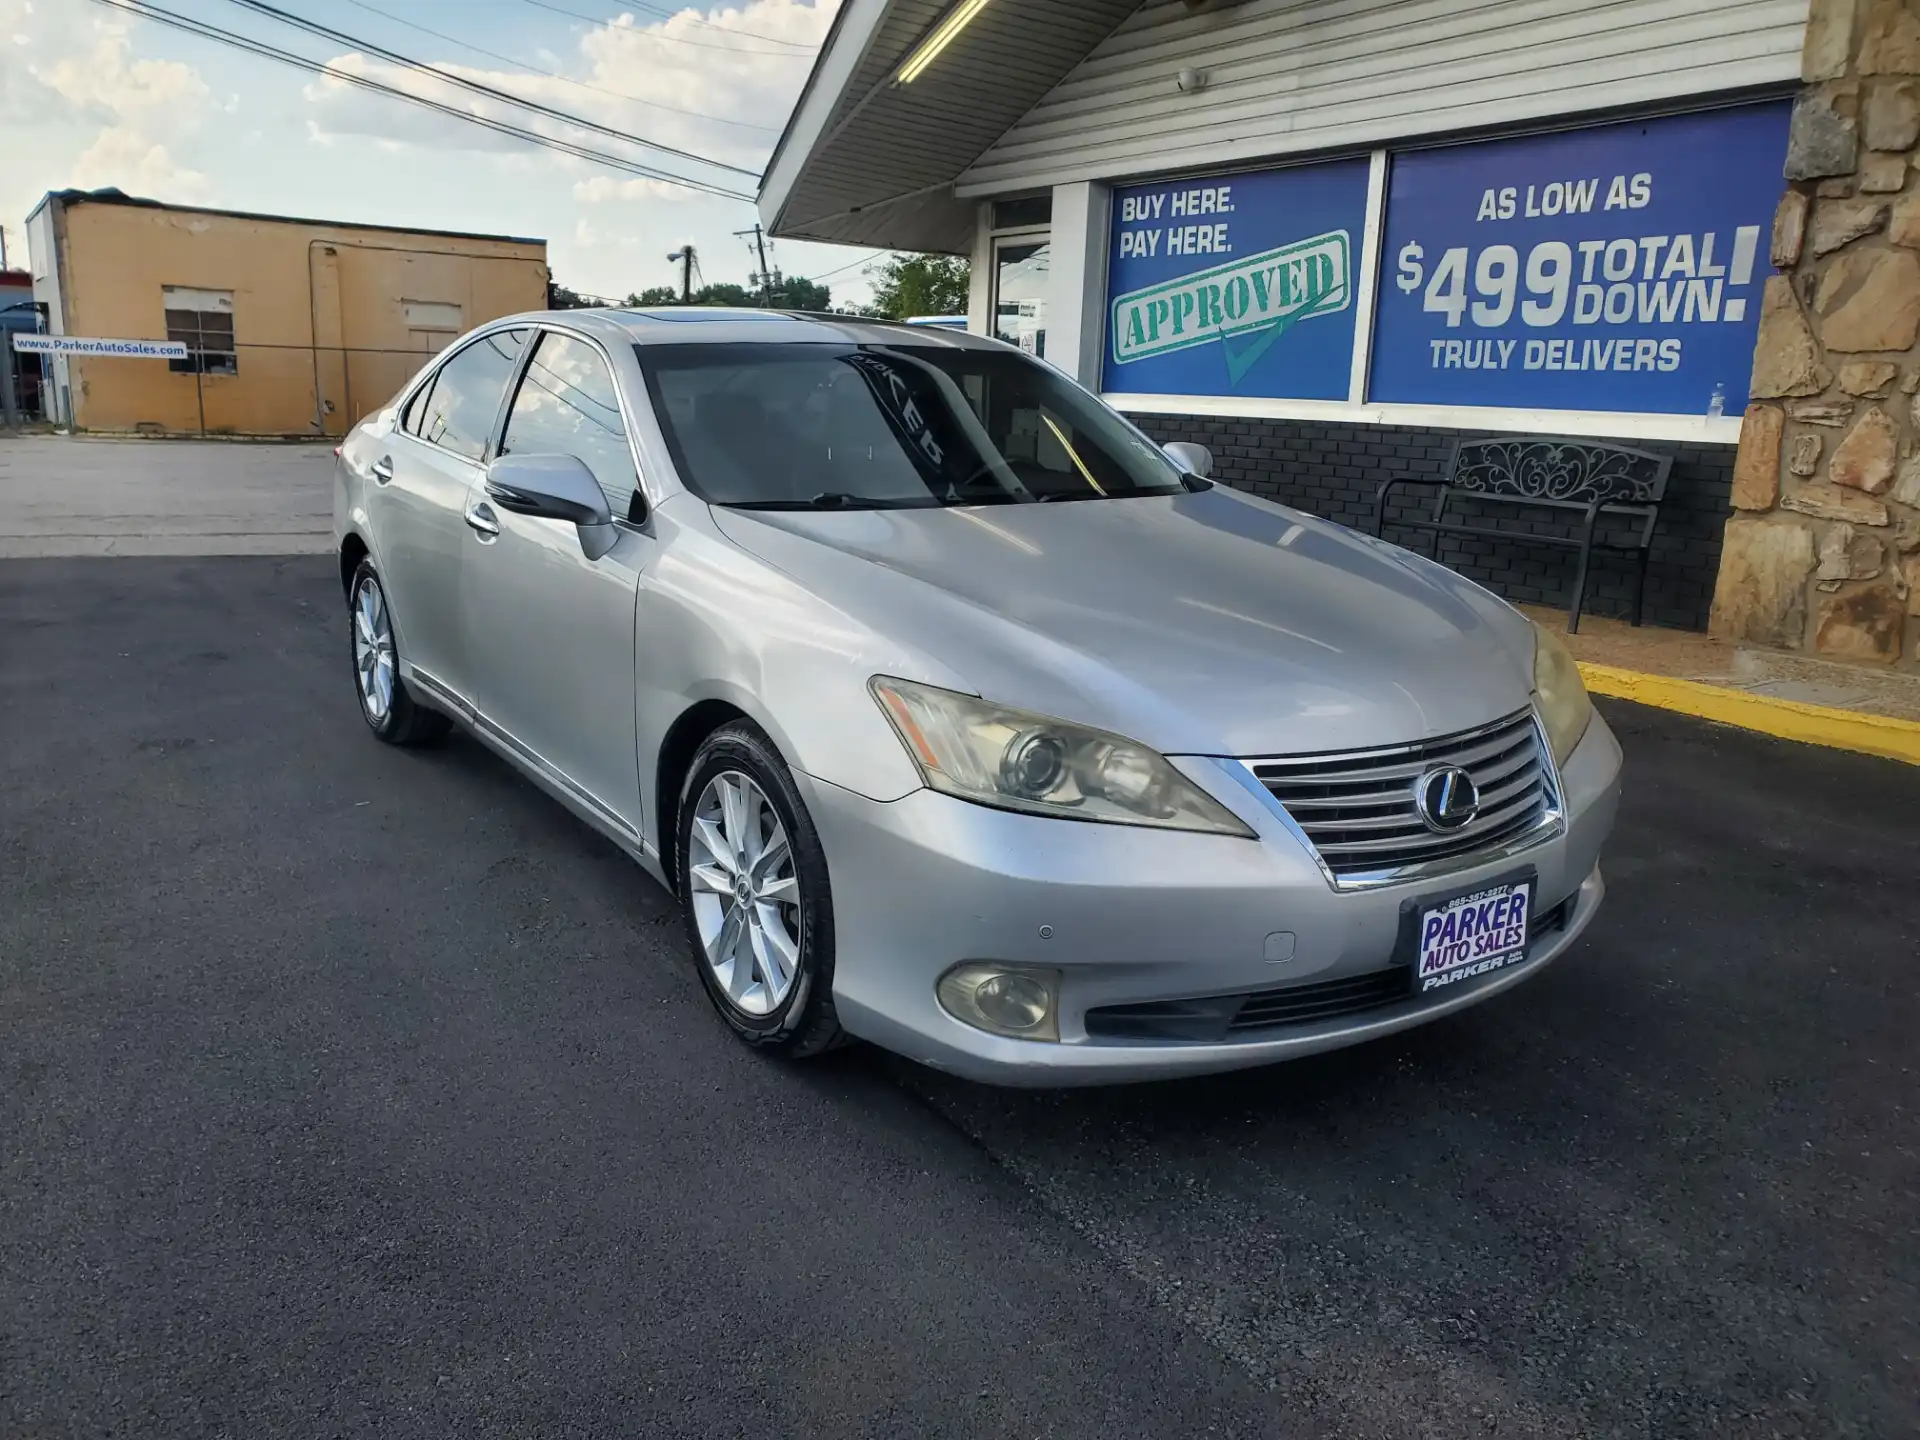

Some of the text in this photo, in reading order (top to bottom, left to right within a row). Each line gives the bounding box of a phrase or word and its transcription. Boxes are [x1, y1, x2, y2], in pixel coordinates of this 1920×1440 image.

[1121, 186, 1235, 222] BUY HERE.
[1476, 172, 1652, 221] AS LOW AS
[1119, 223, 1232, 259] PAY HERE.
[1577, 232, 1726, 283] TOTAL
[1123, 252, 1335, 349] APPROVED
[16, 339, 184, 356] www.ParkerAutoSales.com
[1430, 337, 1682, 372] TRULY DELIVERS
[1422, 892, 1526, 952] PARKER
[1422, 924, 1524, 974] AUTO SALES
[1422, 955, 1505, 992] PARKER
